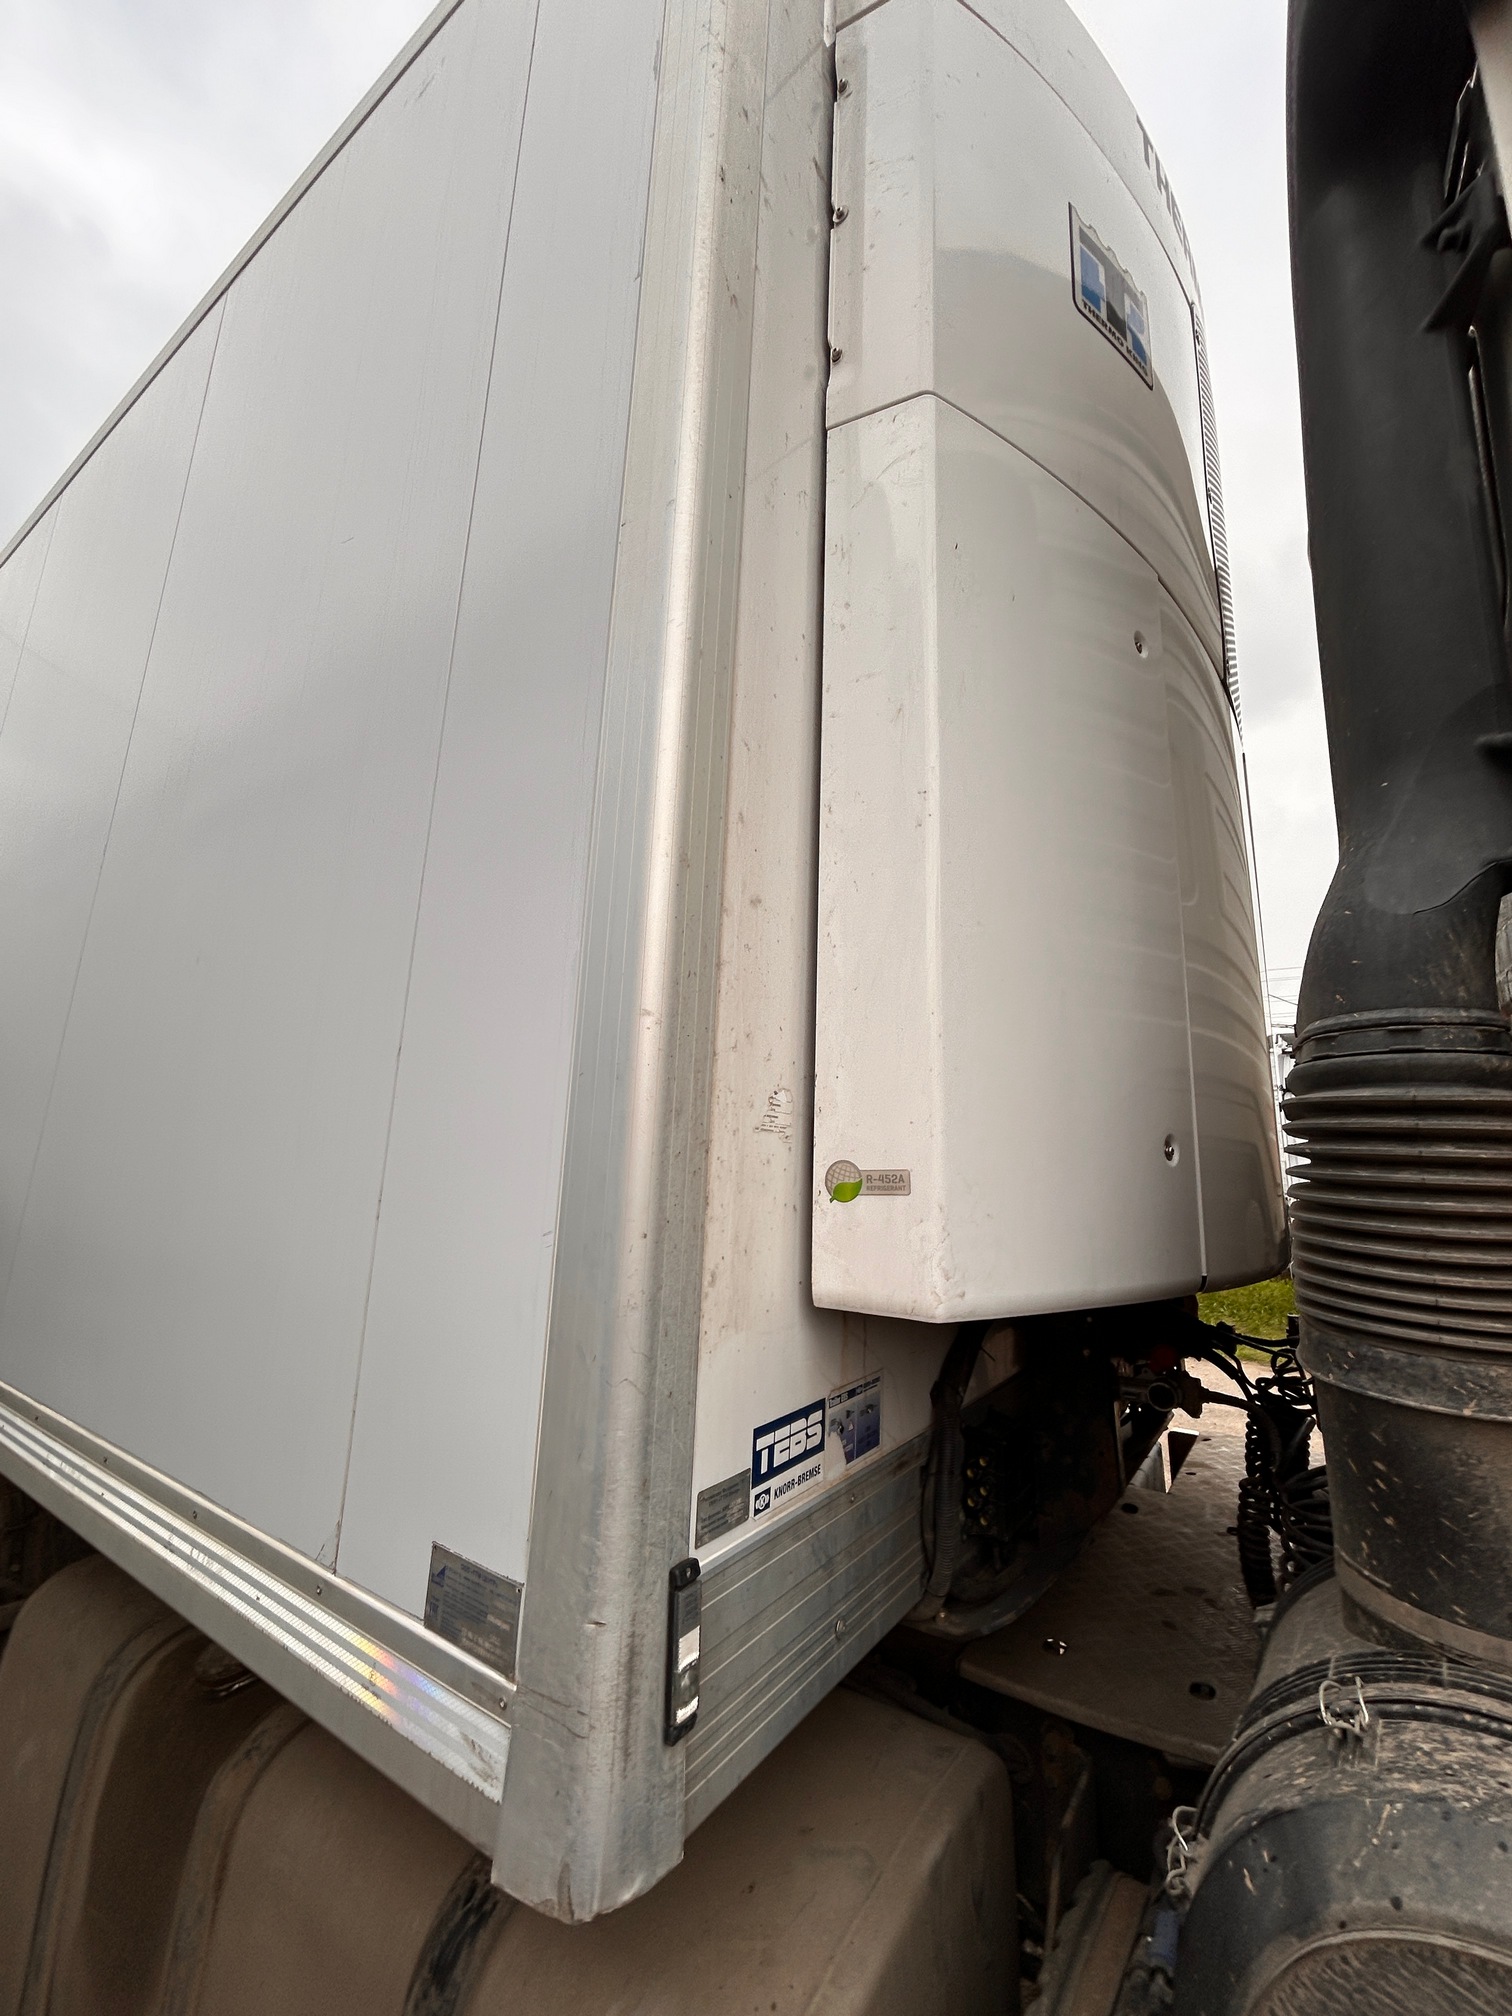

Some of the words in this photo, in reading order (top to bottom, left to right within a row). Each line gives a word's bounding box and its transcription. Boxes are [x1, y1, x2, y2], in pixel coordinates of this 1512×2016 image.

[1082, 299, 1124, 348] THERMO
[866, 1174, 905, 1184] R-452A
[756, 1409, 823, 1475] TEBS
[773, 1464, 821, 1500] KNORR-BREMSE
